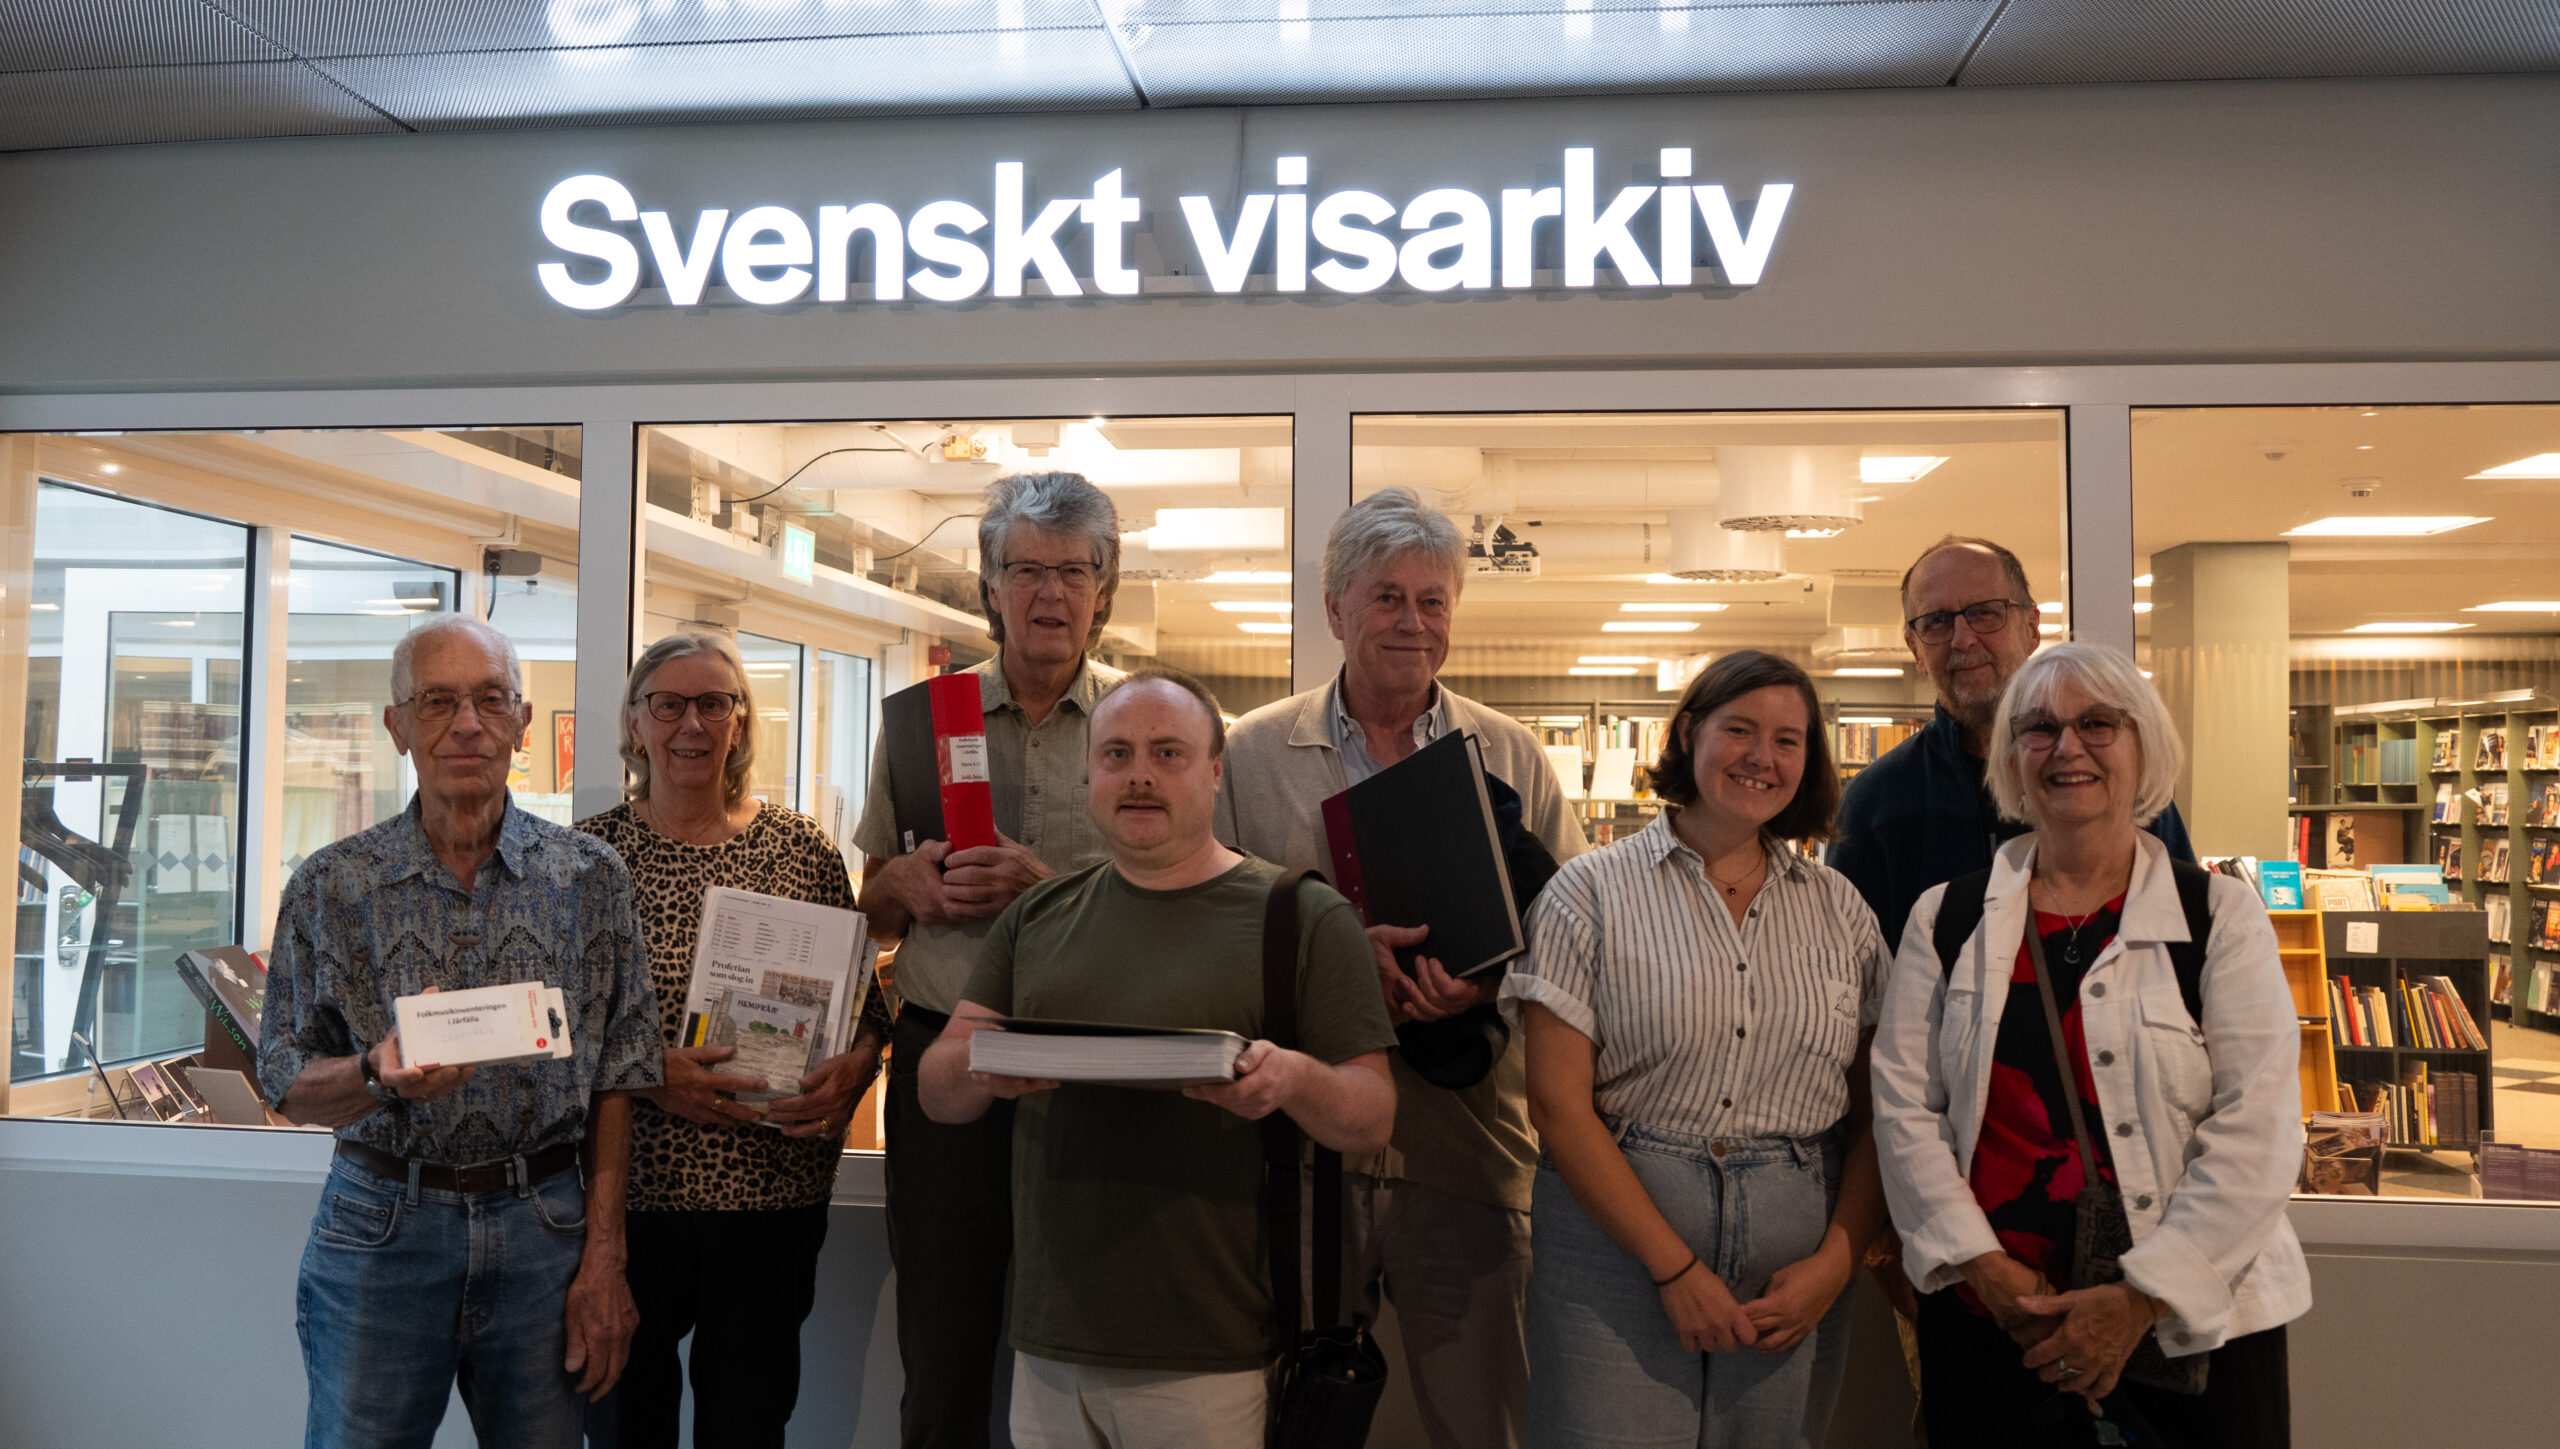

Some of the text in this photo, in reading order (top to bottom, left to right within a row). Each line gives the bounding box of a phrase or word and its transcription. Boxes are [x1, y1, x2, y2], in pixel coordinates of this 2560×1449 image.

[538, 147, 1794, 310] Svenskt visarkiv
[711, 960, 751, 974] Profetian
[709, 971, 727, 981] som
[727, 973, 745, 985] slog
[746, 976, 754, 984] in
[416, 1003, 507, 1019] Folkmusikinventeringen
[452, 1016, 479, 1025] Järfälla
